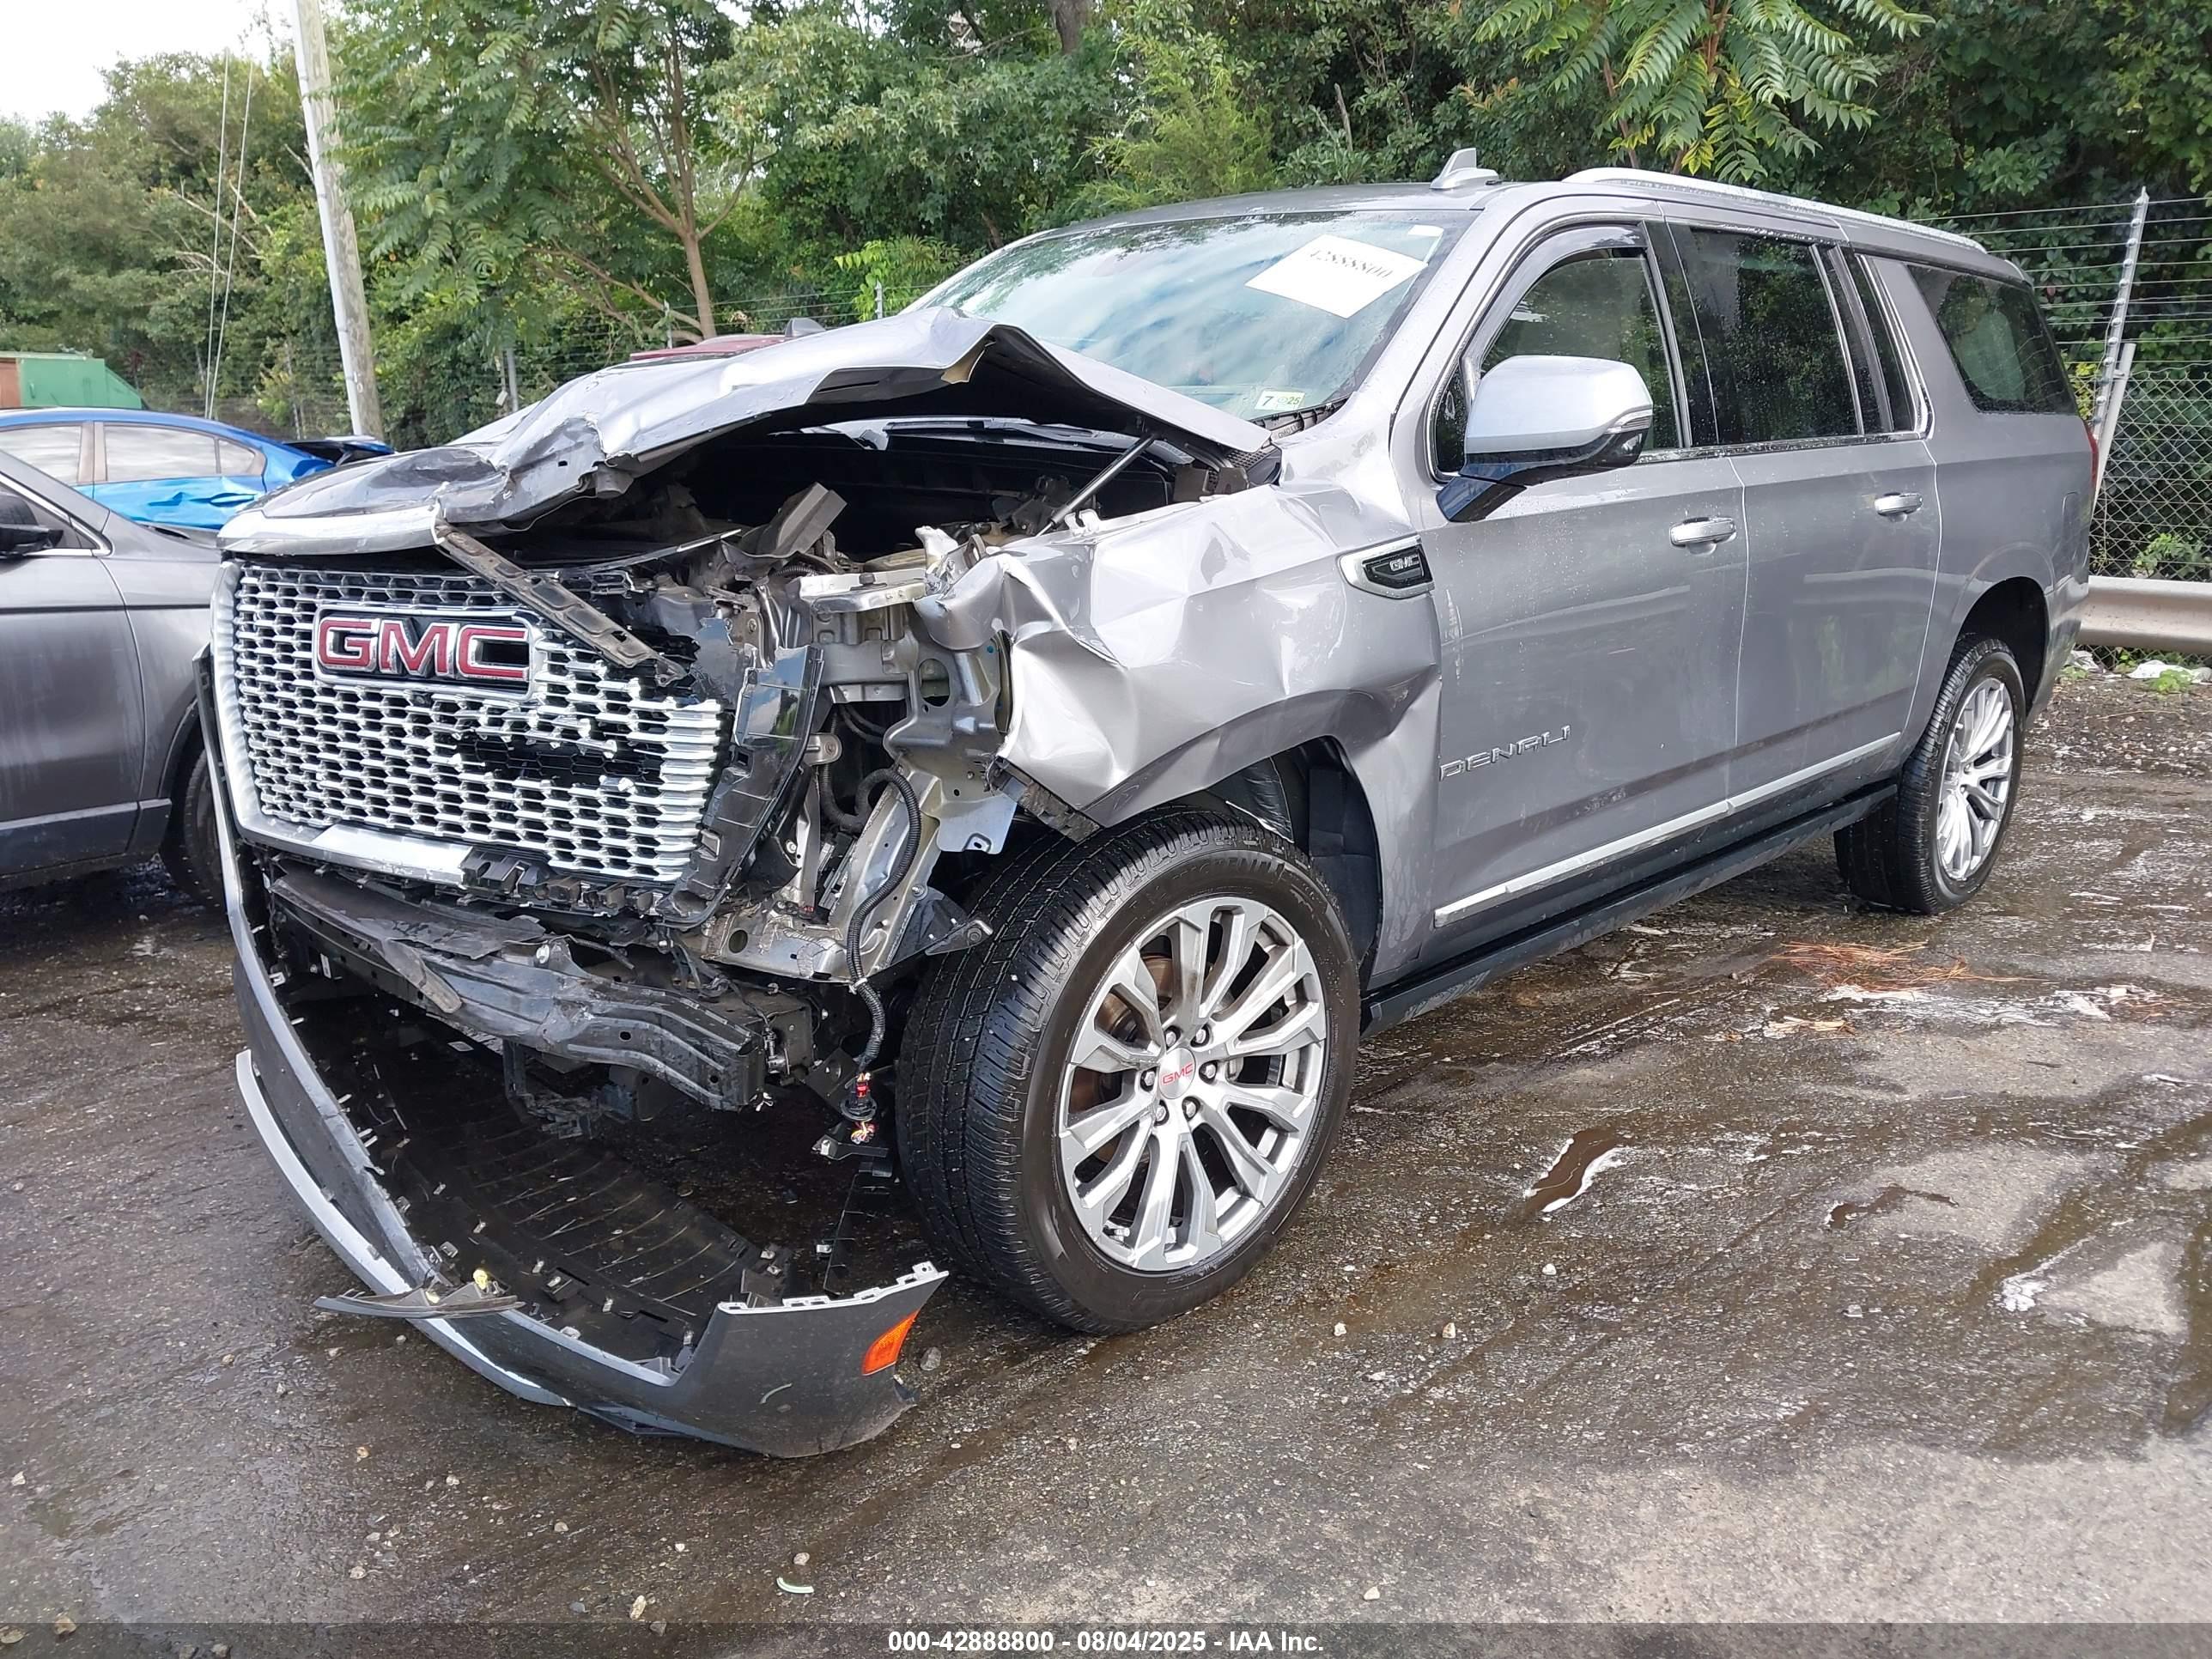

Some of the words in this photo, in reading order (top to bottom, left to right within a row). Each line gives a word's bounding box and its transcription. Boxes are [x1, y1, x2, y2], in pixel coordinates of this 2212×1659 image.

[1262, 396, 1274, 406] 7
[1286, 396, 1302, 405] 25
[1389, 554, 1419, 572] GMC
[317, 617, 529, 682] GMC
[1439, 725, 1571, 781] DENALI
[1163, 1063, 1194, 1085] GMC
